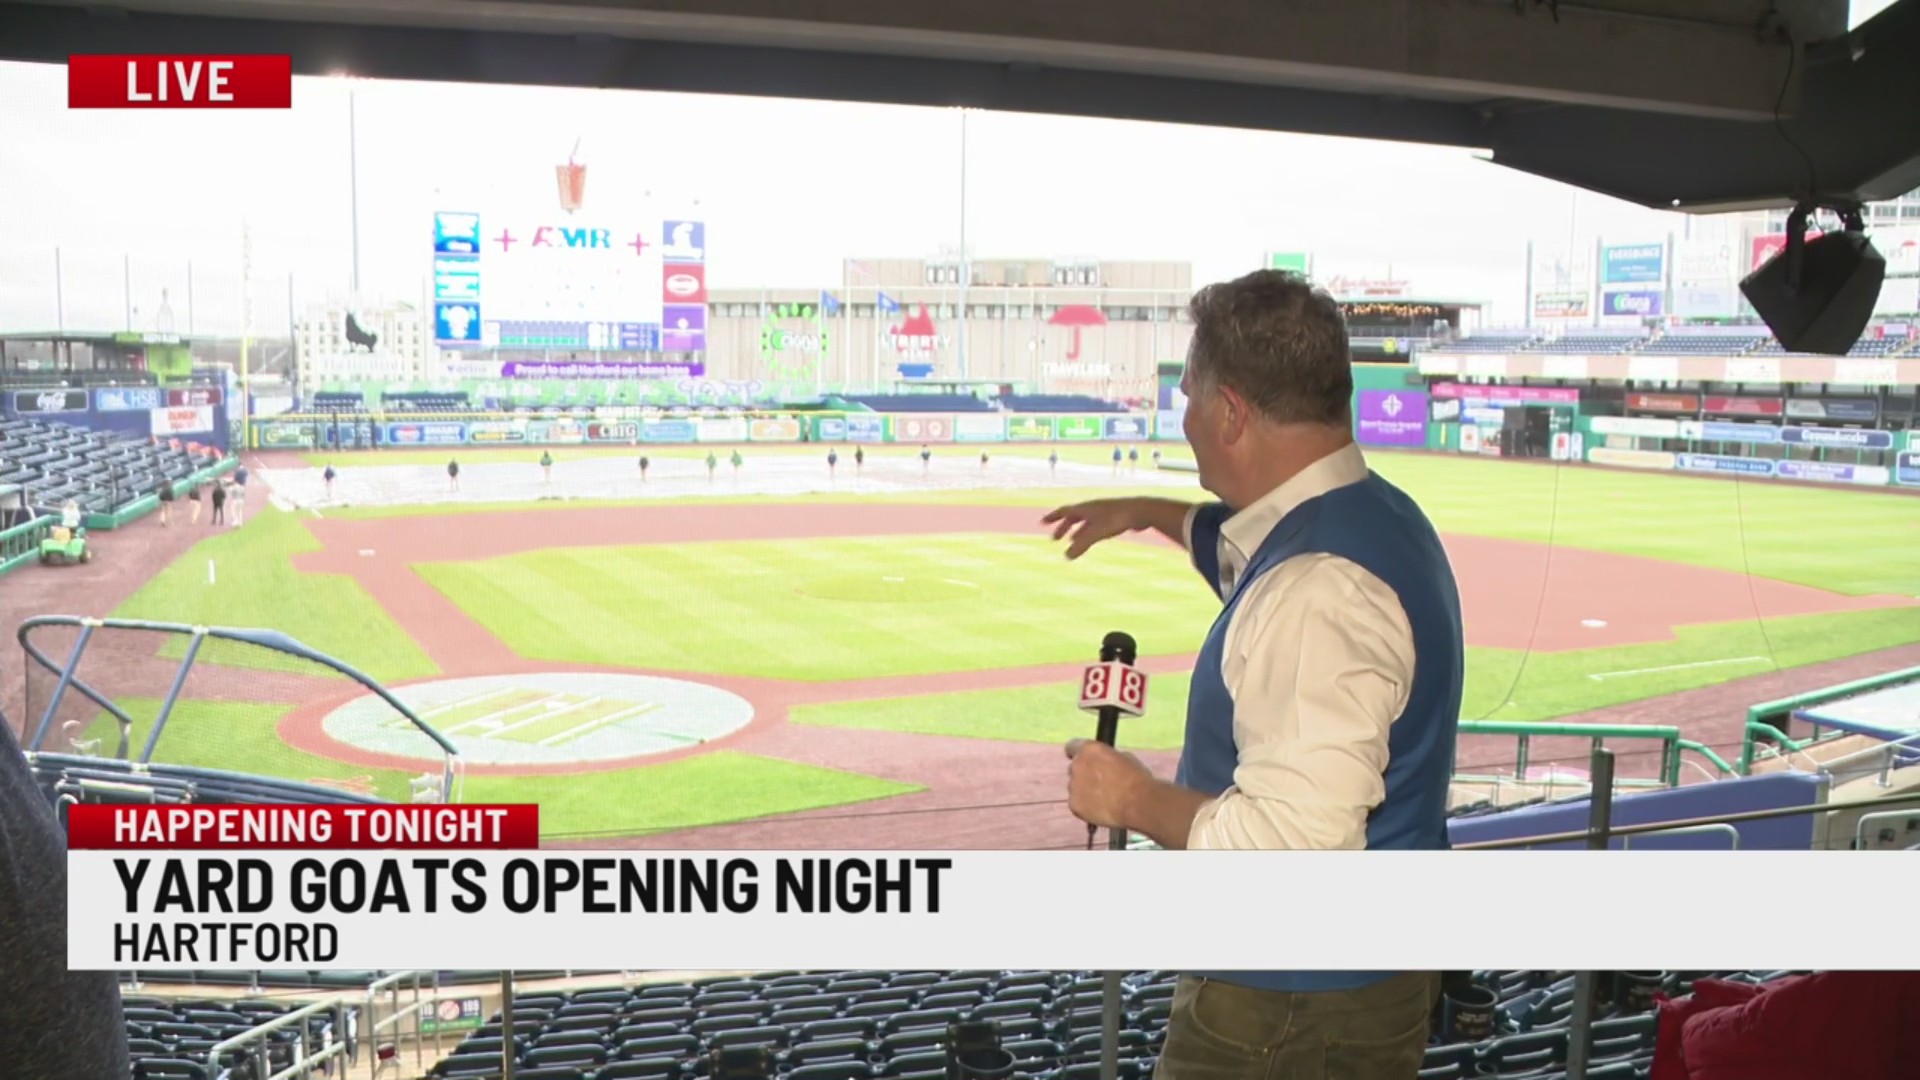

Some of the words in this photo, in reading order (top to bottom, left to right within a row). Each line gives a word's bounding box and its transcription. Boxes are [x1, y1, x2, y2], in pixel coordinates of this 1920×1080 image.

[532, 227, 612, 249] AMR
[579, 364, 620, 374] Hartford
[1085, 666, 1106, 699] 8
[1122, 671, 1142, 705] 8
